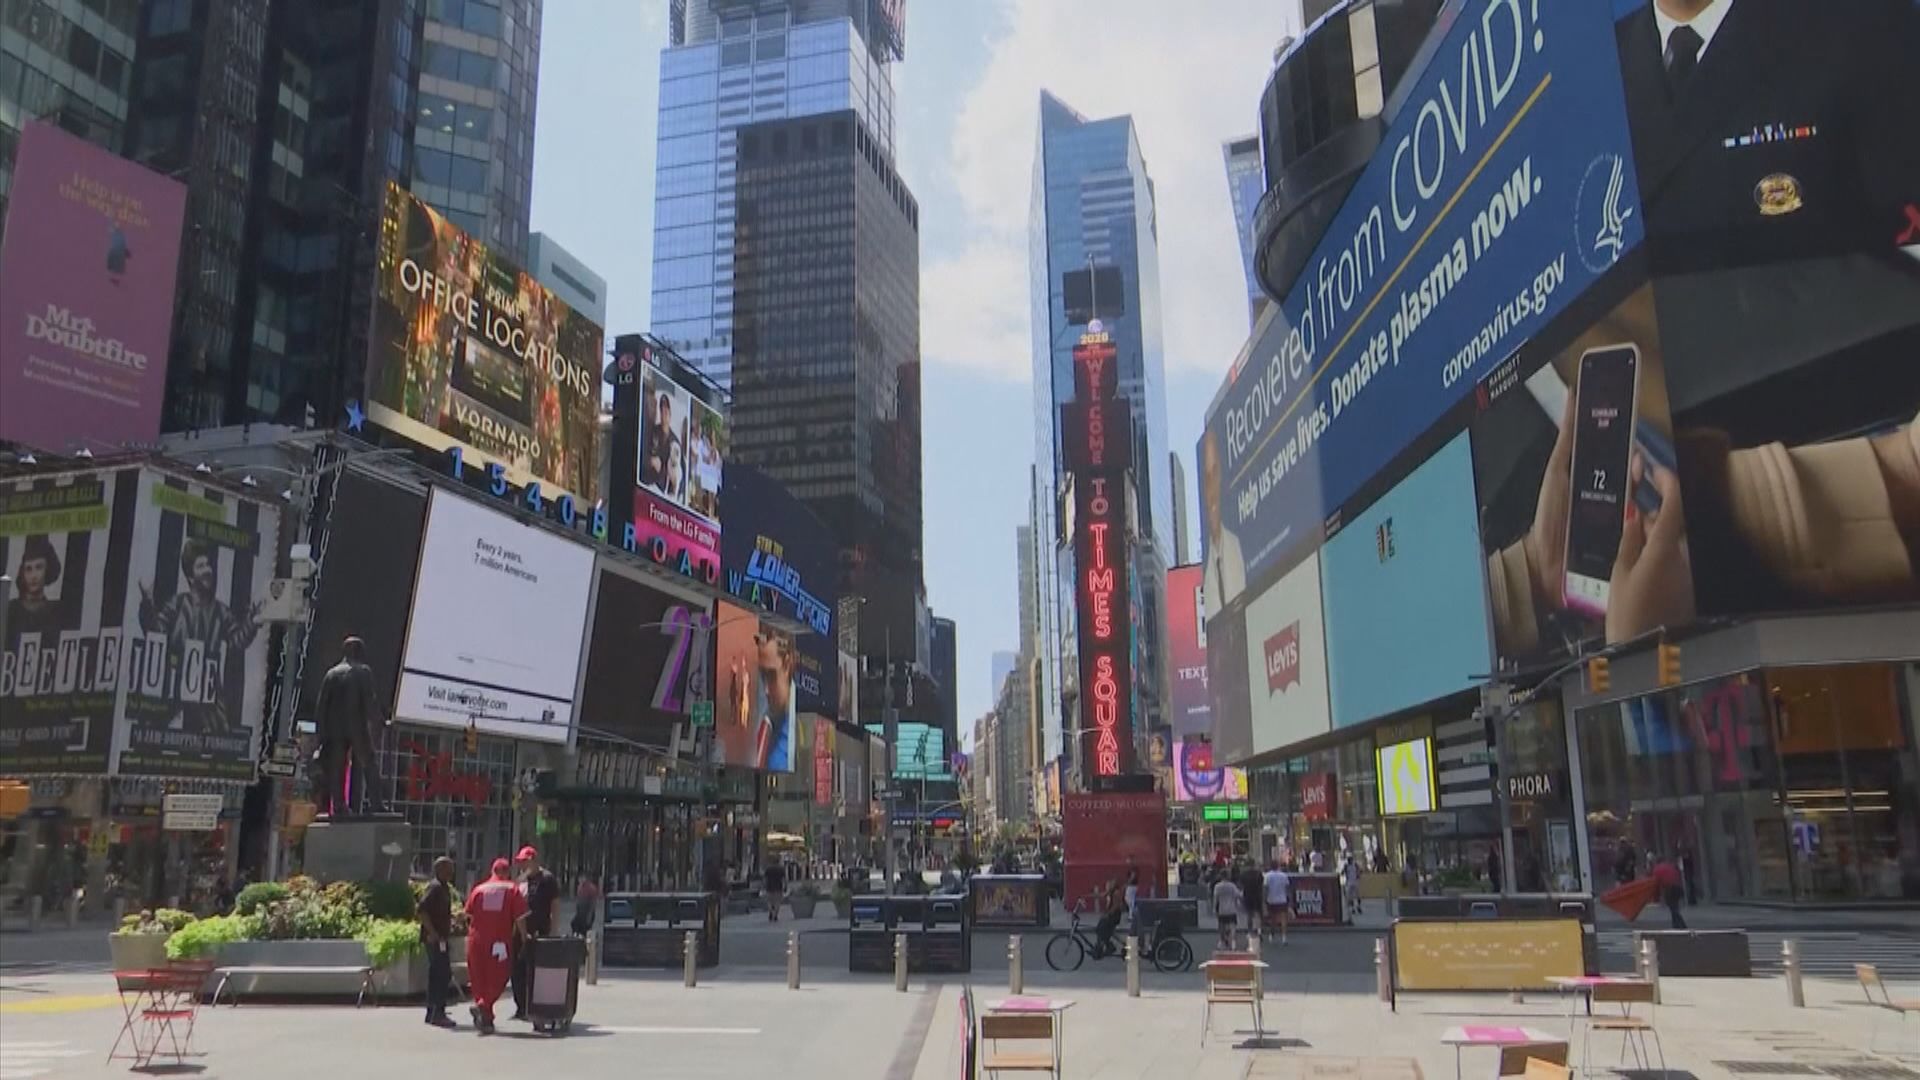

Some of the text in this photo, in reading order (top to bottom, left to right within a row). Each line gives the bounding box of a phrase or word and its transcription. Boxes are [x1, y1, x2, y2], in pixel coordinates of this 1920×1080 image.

[24, 313, 148, 369] Doubtfire
[399, 258, 591, 398] OFFICE LOCATIONS
[1226, 286, 1314, 469] Recovered
[1318, 204, 1387, 342] from
[1237, 474, 1260, 524] Help
[1259, 464, 1271, 497] us
[1270, 438, 1299, 487] save
[1330, 335, 1389, 419] Donate
[1391, 243, 1469, 354] plasma
[1470, 156, 1543, 263] now.
[1441, 252, 1567, 389] coronavirus.gov
[617, 372, 634, 385] LG
[454, 401, 541, 458] VORNADO
[1086, 358, 1104, 465] WELCOME
[448, 446, 577, 527] 1540
[1090, 478, 1109, 516] TO
[1593, 469, 1607, 490] 72
[476, 537, 497, 556] Every
[497, 544, 503, 557] 2
[649, 503, 717, 551] From the LG Family
[474, 552, 538, 584] 7 million Americans
[746, 548, 801, 598] LOWER
[1088, 523, 1114, 637] TIMES
[427, 684, 447, 702] Visit
